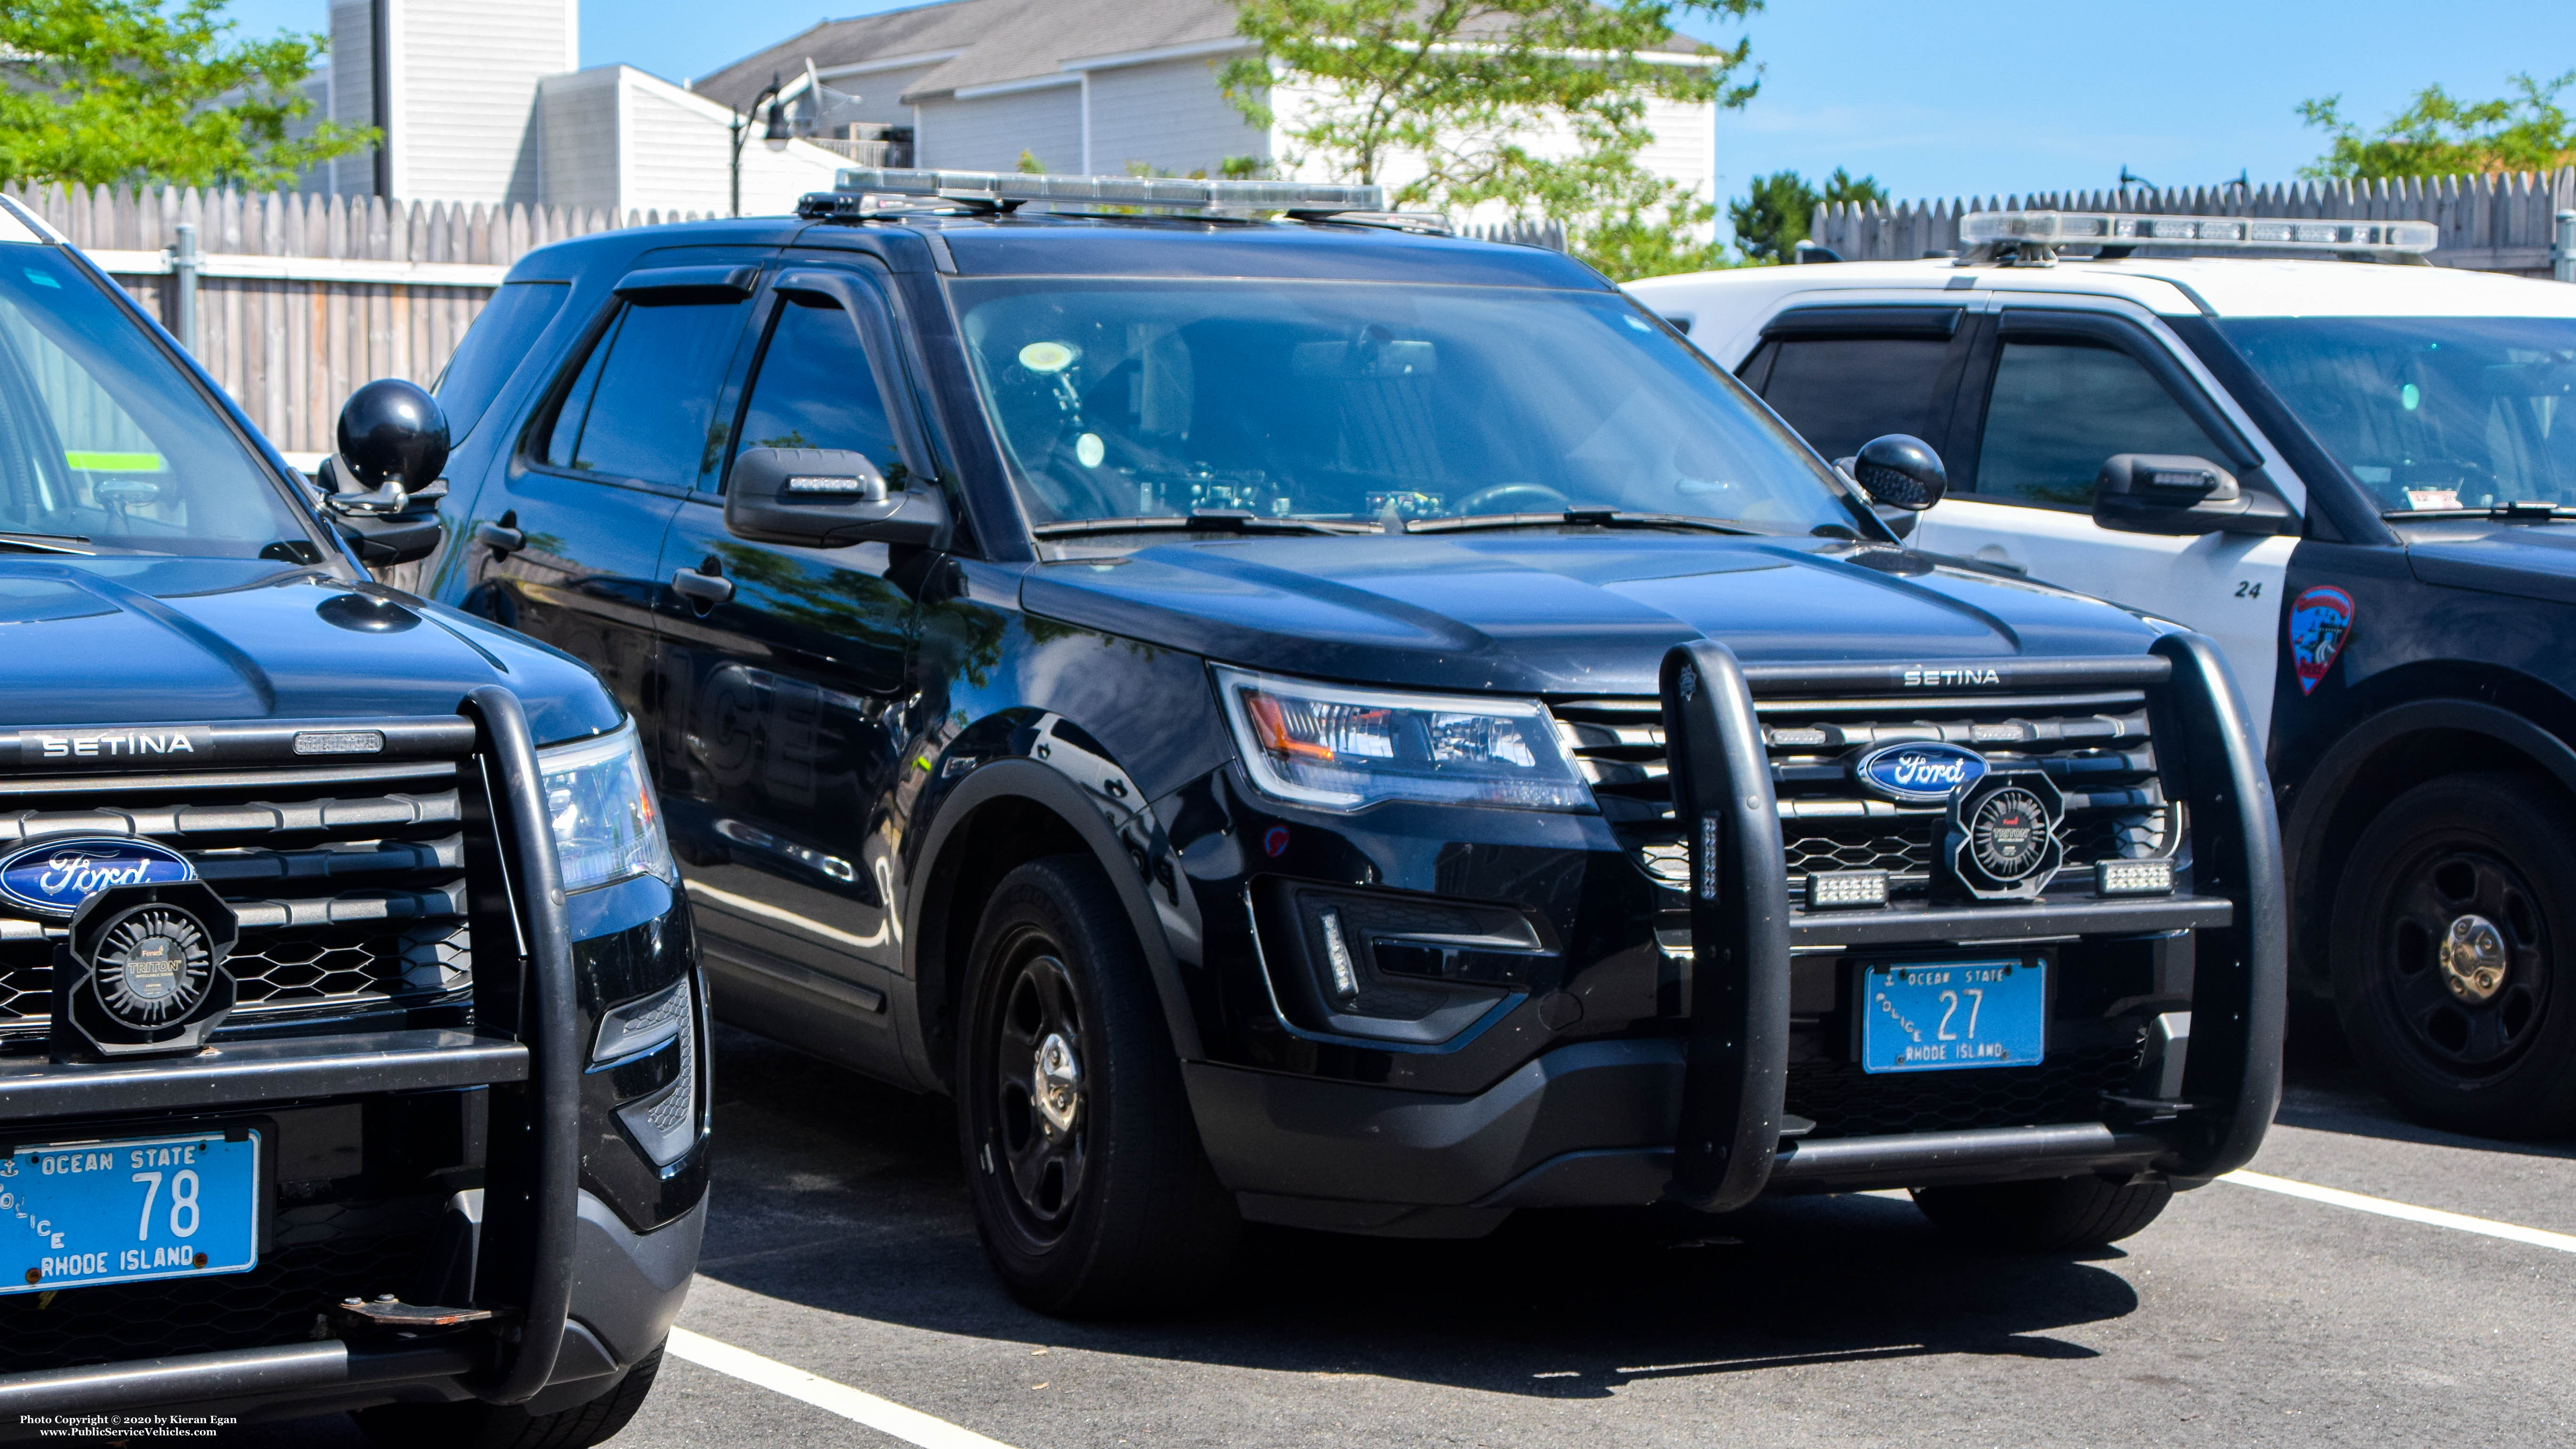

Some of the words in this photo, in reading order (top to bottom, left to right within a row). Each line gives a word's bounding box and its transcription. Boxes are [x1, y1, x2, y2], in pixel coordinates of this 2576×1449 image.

[2235, 581, 2262, 598] 24
[1904, 670, 2000, 687] SETINA
[43, 734, 193, 757] SETINA
[1894, 751, 1965, 785] Ford
[40, 849, 151, 895] Ford
[1908, 972, 1950, 986] OCEAN
[1966, 969, 2004, 982] STATE
[1875, 992, 1922, 1042] POLICE
[1937, 988, 1983, 1041] 27
[1905, 1045, 1946, 1061] RHODE
[1956, 1043, 2003, 1059] ISLAND
[42, 1153, 113, 1175] OCEAN
[131, 1146, 196, 1169] STATE
[0, 1183, 64, 1249] OLICE
[132, 1169, 200, 1241] 78
[41, 1252, 108, 1277] RHODE
[120, 1245, 193, 1271] ISLAND
